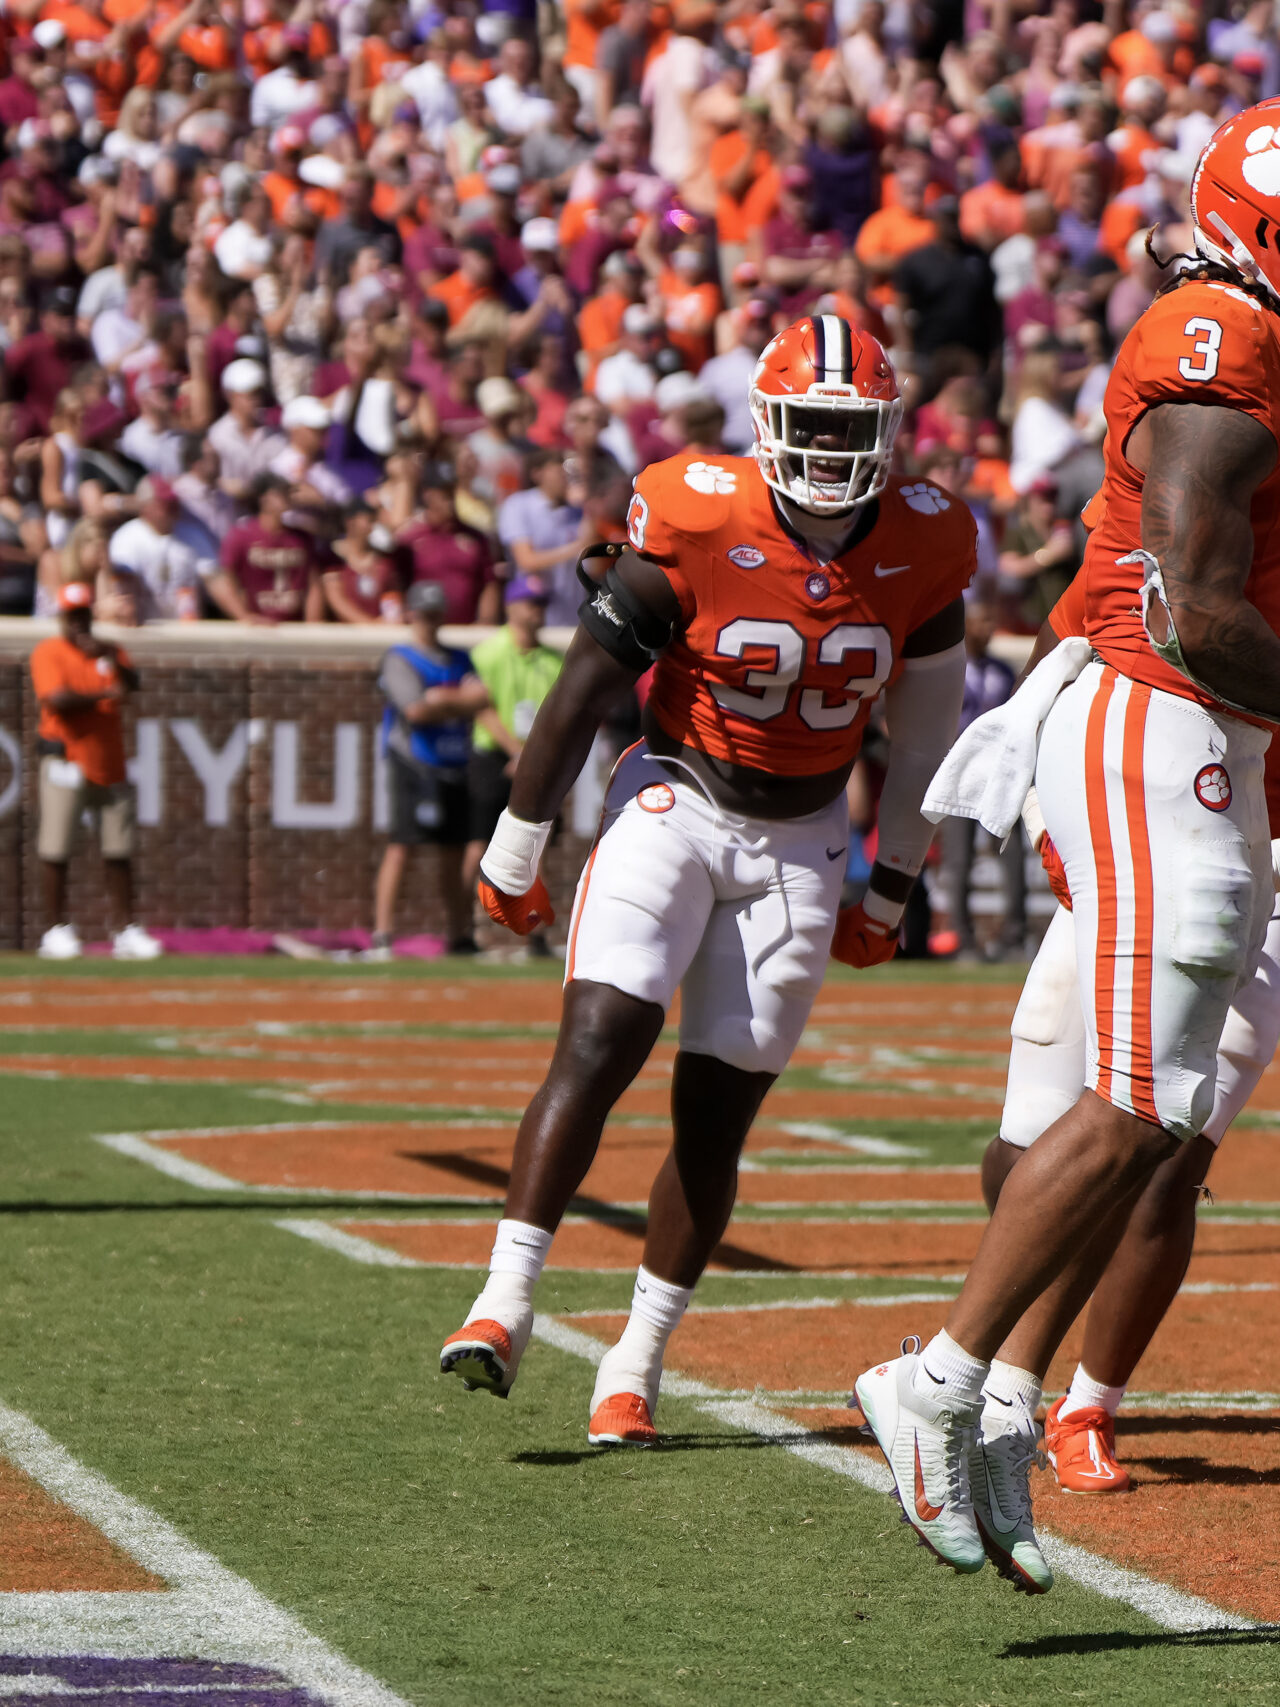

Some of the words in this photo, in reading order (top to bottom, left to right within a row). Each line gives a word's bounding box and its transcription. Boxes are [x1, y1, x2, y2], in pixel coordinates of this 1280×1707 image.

[1178, 317, 1223, 382] 3
[733, 550, 760, 562] ACC
[709, 616, 893, 731] 33
